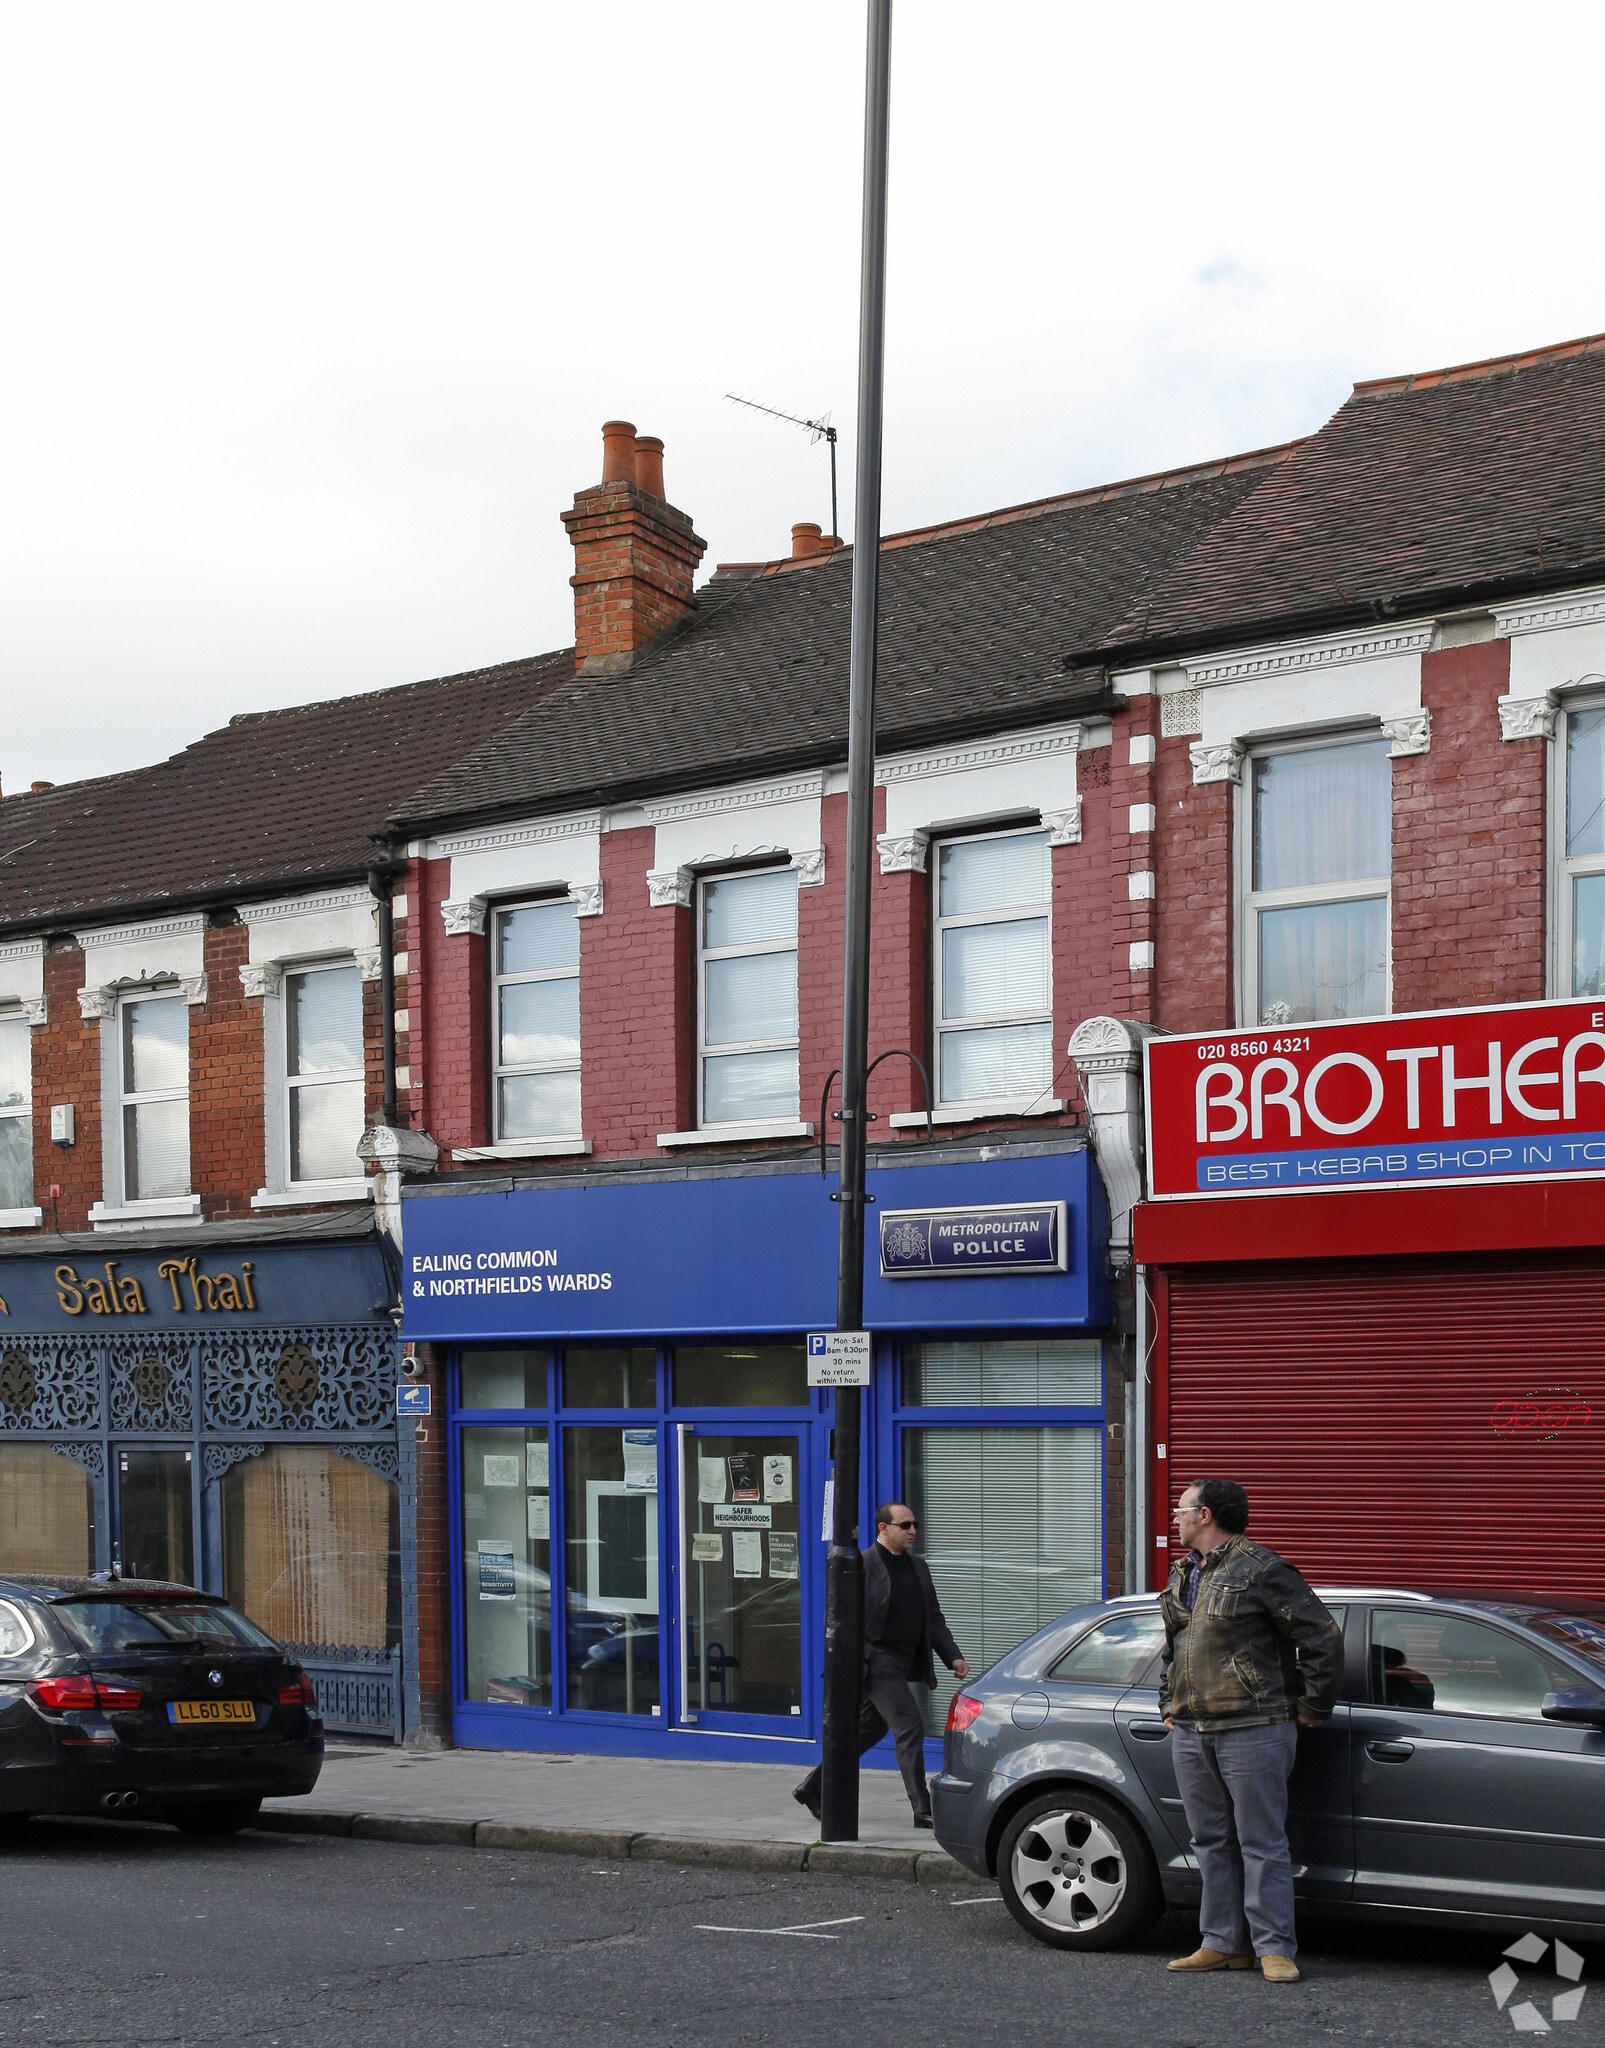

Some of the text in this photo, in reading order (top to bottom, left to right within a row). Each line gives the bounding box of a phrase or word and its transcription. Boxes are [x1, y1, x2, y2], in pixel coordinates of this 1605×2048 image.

[1198, 1037, 1311, 1060] 020 8560 4321
[1195, 1031, 1605, 1143] BROTHER
[1206, 1162, 1289, 1182] BEST
[1298, 1154, 1408, 1177] KEBAB
[1417, 1148, 1512, 1171] SHOP
[1523, 1145, 1552, 1164] IN
[938, 1220, 1040, 1238] METROPOLITAN
[953, 1239, 1026, 1255] POLICE
[412, 1249, 558, 1273] EALING COMMON
[54, 1262, 147, 1315] Sala
[158, 1256, 260, 1311] Thai
[412, 1272, 613, 1297] & NORTHFIELDS WARDS
[812, 1336, 824, 1354] P
[715, 1514, 770, 1522] NEIGHBOURHOODS
[732, 1507, 753, 1515] SAFER
[178, 1703, 252, 1719] LL60 SLU
